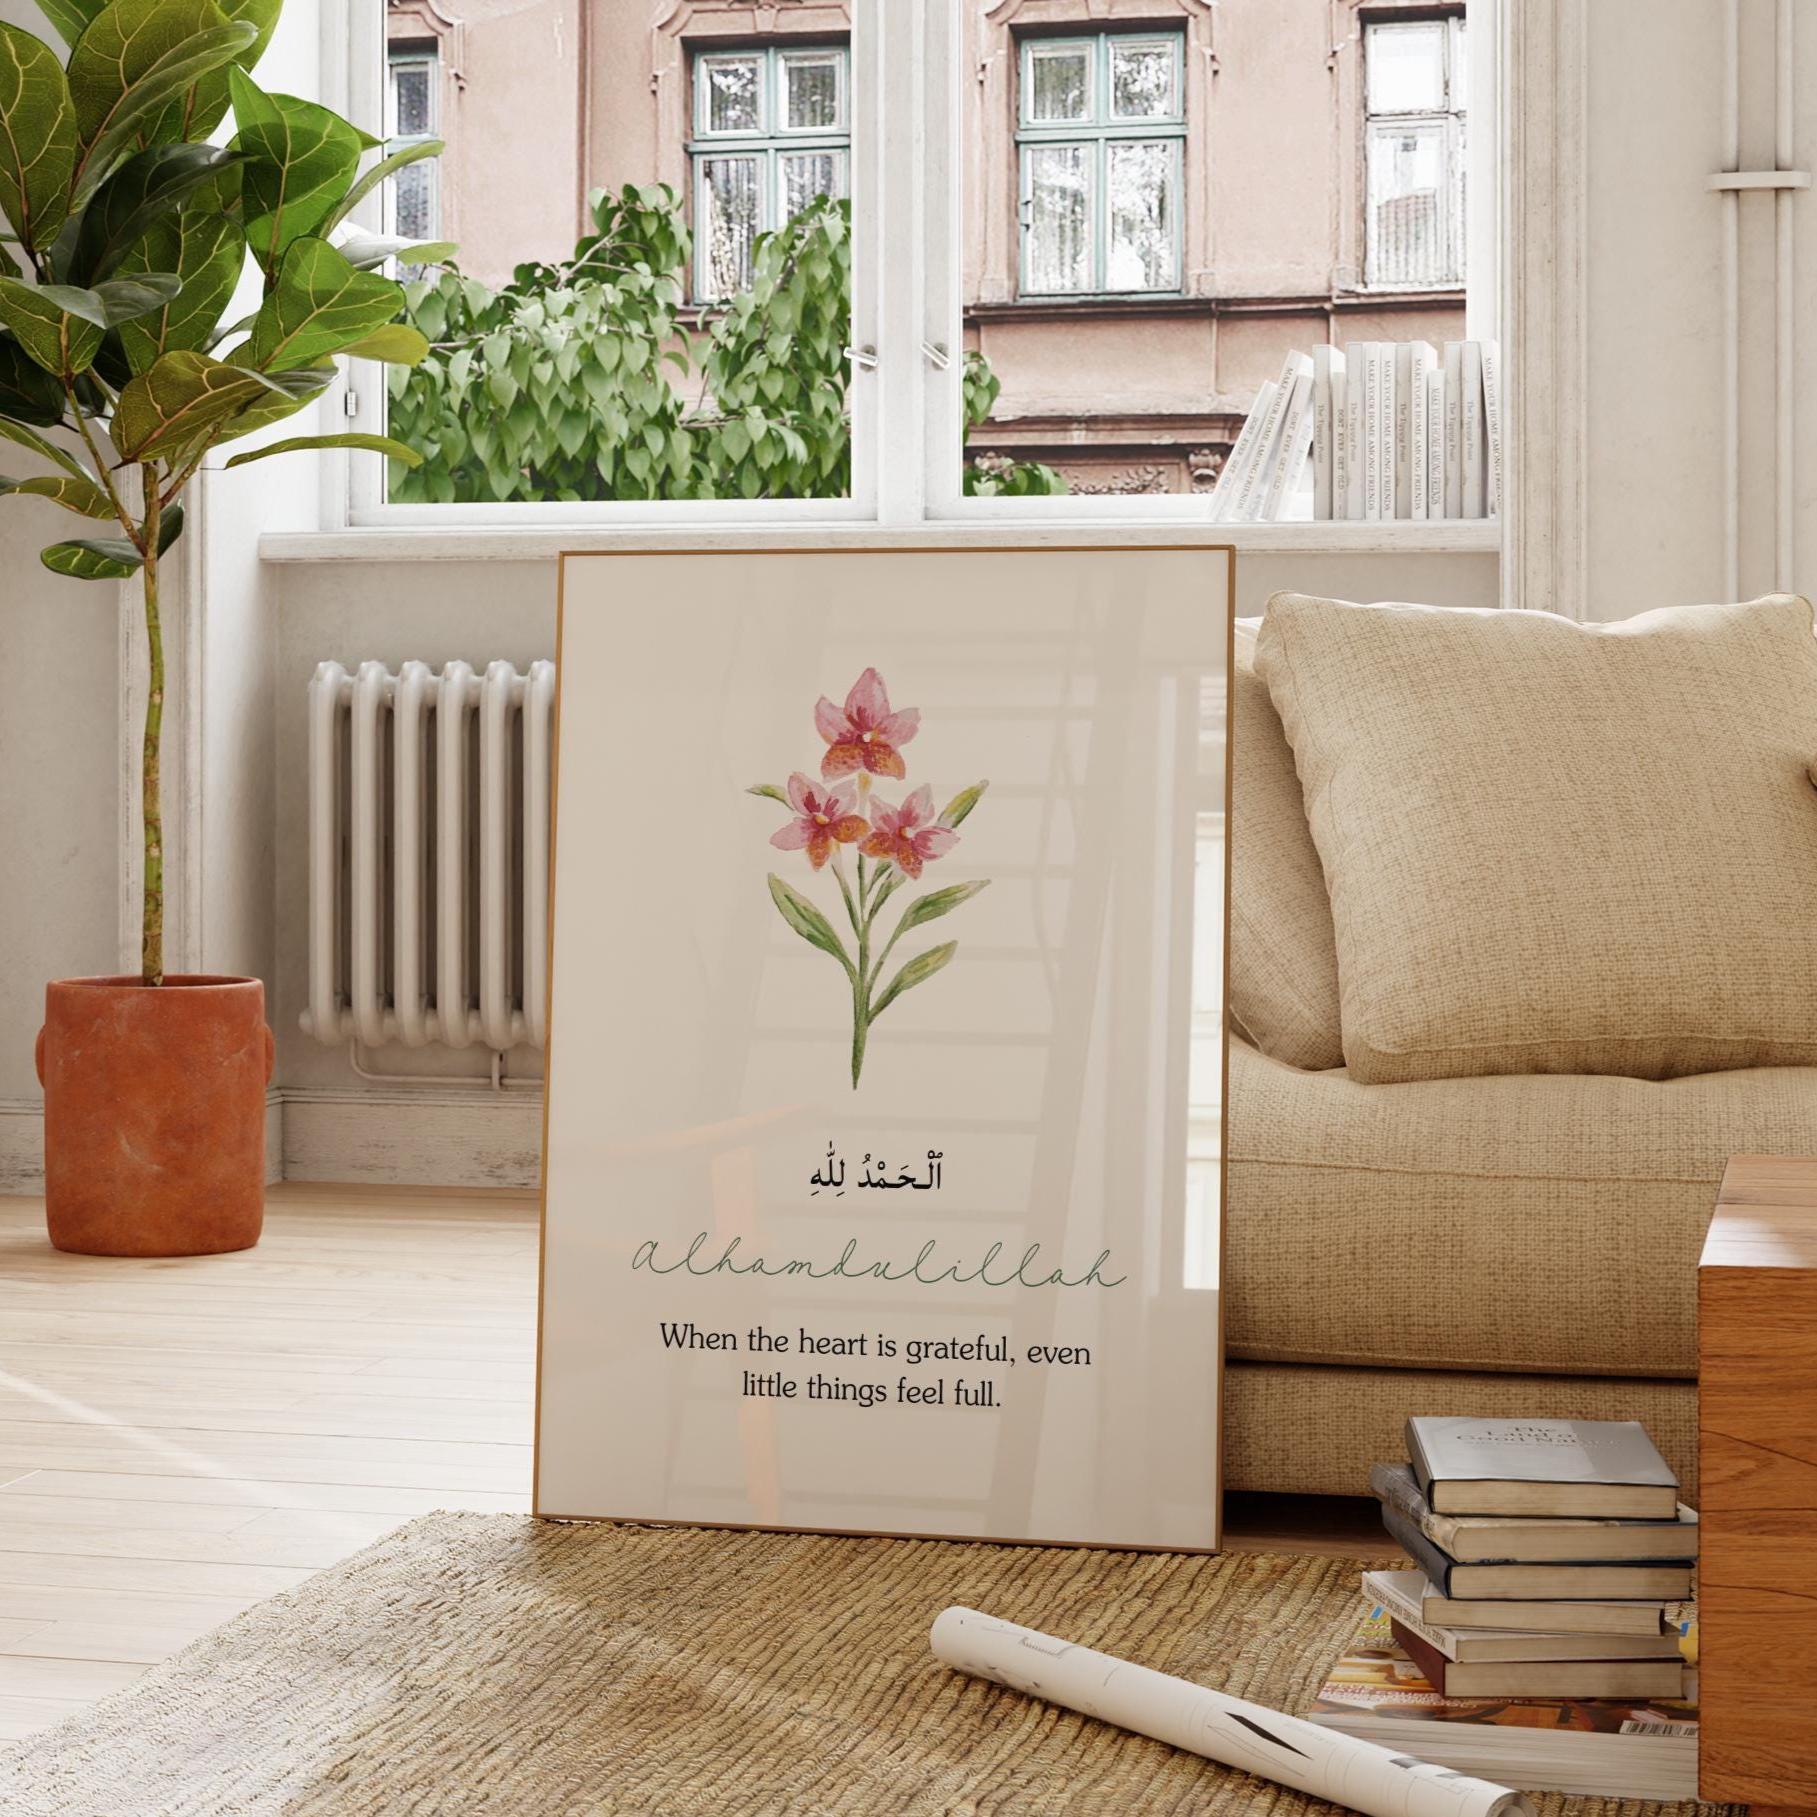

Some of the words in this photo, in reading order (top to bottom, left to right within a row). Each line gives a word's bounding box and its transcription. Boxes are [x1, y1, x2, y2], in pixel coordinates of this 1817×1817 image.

[659, 1322, 738, 1351] When
[746, 1326, 790, 1353] the
[798, 1327, 868, 1356] heart
[876, 1328, 897, 1358] is
[906, 1333, 1016, 1367] grateful,
[1026, 1345, 1092, 1366] even
[742, 1370, 798, 1399] little
[806, 1373, 888, 1408] things
[896, 1375, 945, 1405] feel
[954, 1378, 1001, 1408] full.
